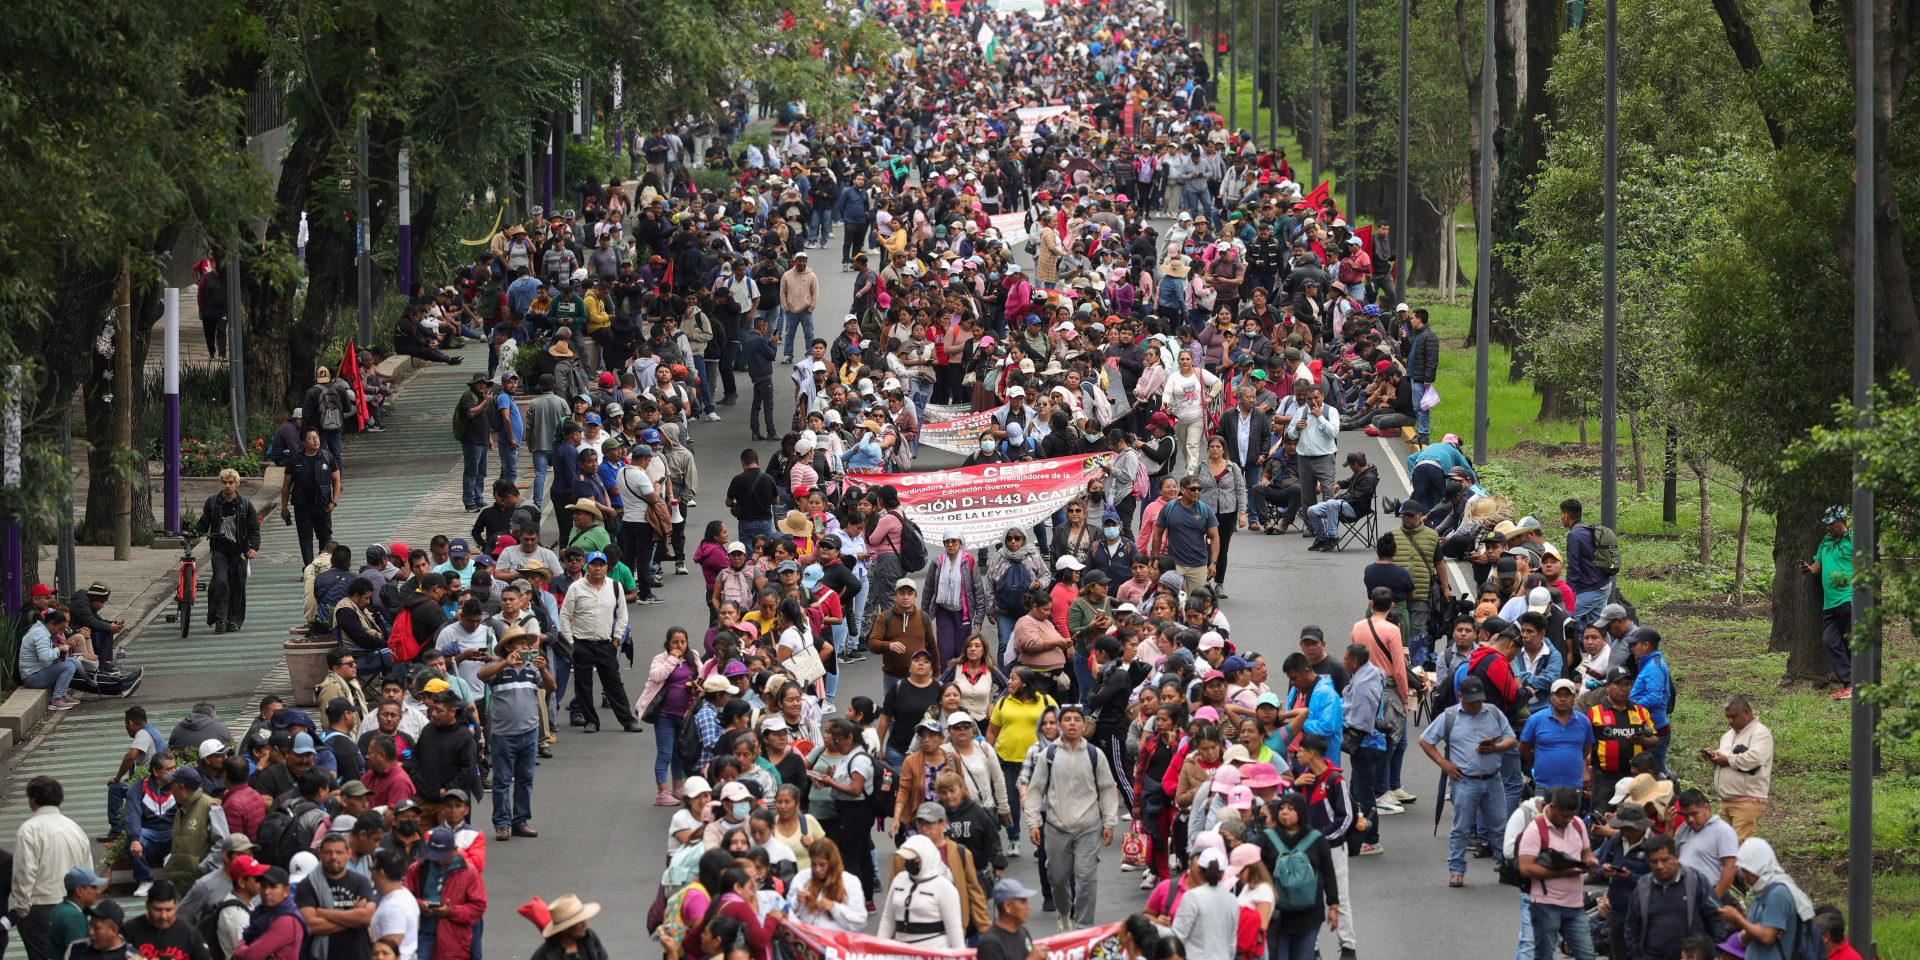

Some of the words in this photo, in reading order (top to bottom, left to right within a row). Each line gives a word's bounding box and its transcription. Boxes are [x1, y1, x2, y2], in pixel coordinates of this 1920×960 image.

[900, 470, 962, 487] CNTE
[1051, 472, 1062, 480] de
[1063, 471, 1071, 480] la
[942, 485, 983, 496] Educación
[984, 483, 1020, 491] Guerrero
[961, 493, 1022, 509] D-1-443
[947, 512, 963, 522] DE
[965, 511, 980, 520] LA
[981, 509, 1002, 519] LEY
[1005, 508, 1026, 517] DEL
